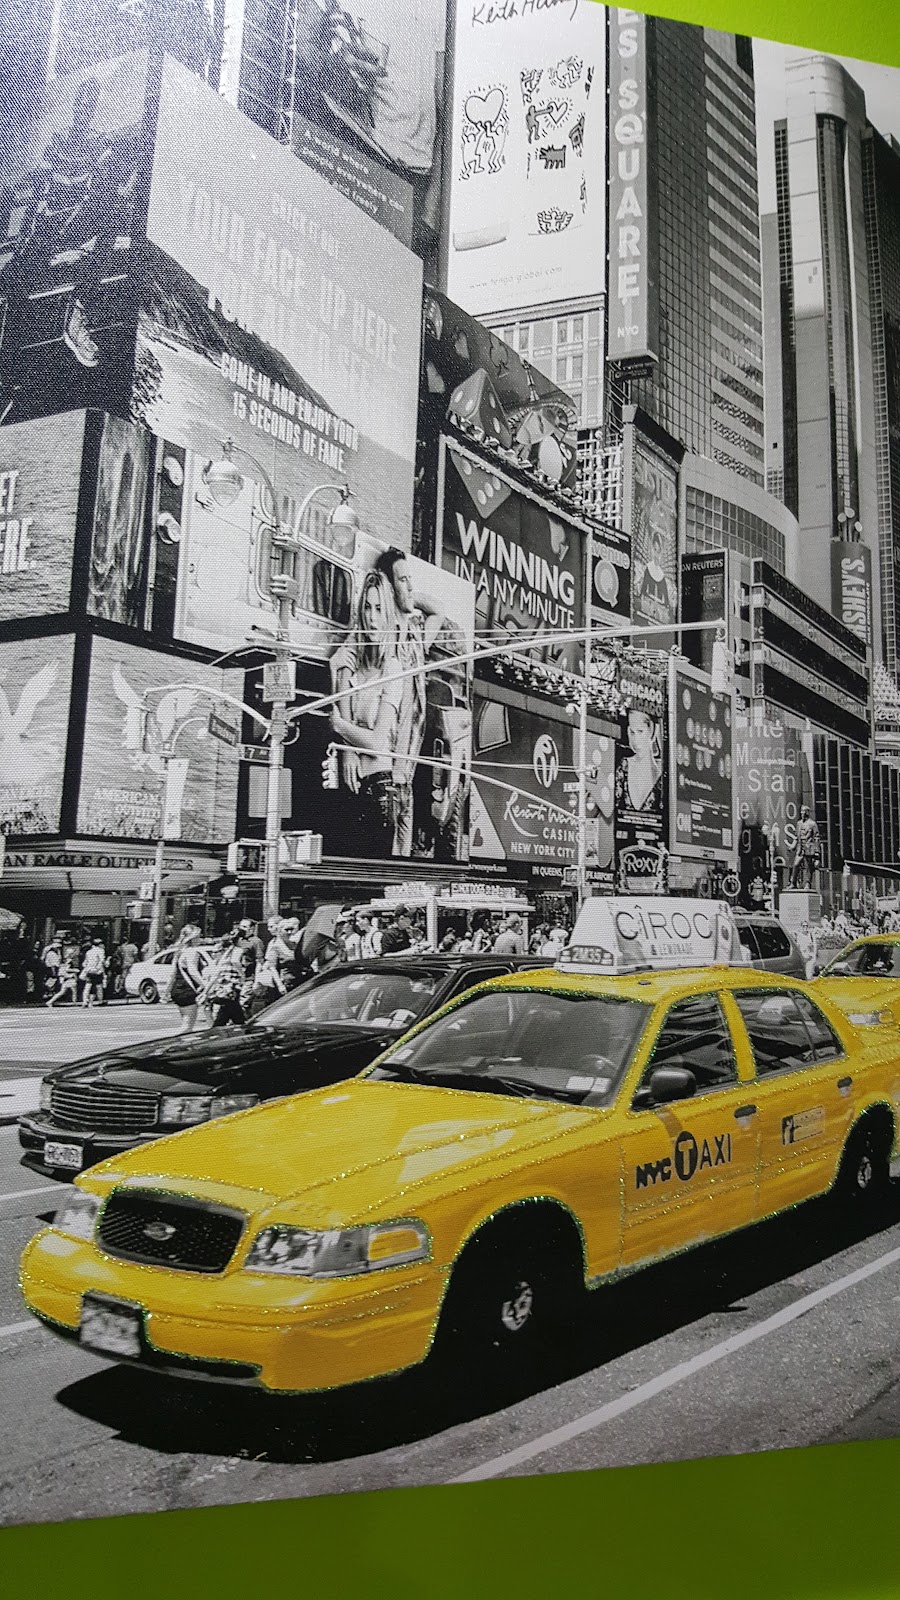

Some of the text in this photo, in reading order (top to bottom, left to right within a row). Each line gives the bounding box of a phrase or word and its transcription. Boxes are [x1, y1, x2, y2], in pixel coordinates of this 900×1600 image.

[614, 79, 645, 300] SQUARE
[617, 326, 639, 338] NYC
[233, 391, 247, 419] 15
[249, 400, 301, 449] SECONDS
[318, 437, 347, 474] FAME
[456, 512, 575, 606] WINNING
[692, 559, 724, 571] REUTERS
[455, 555, 474, 584] IN
[520, 586, 574, 632] MINUTE
[620, 679, 664, 704] CHICAGO
[33, 855, 92, 867] EAGLE
[511, 842, 576, 859] NEW YORK CITY
[532, 866, 540, 875] IN
[615, 904, 713, 940] CÎROC
[636, 1131, 732, 1189] NYC TAXI
